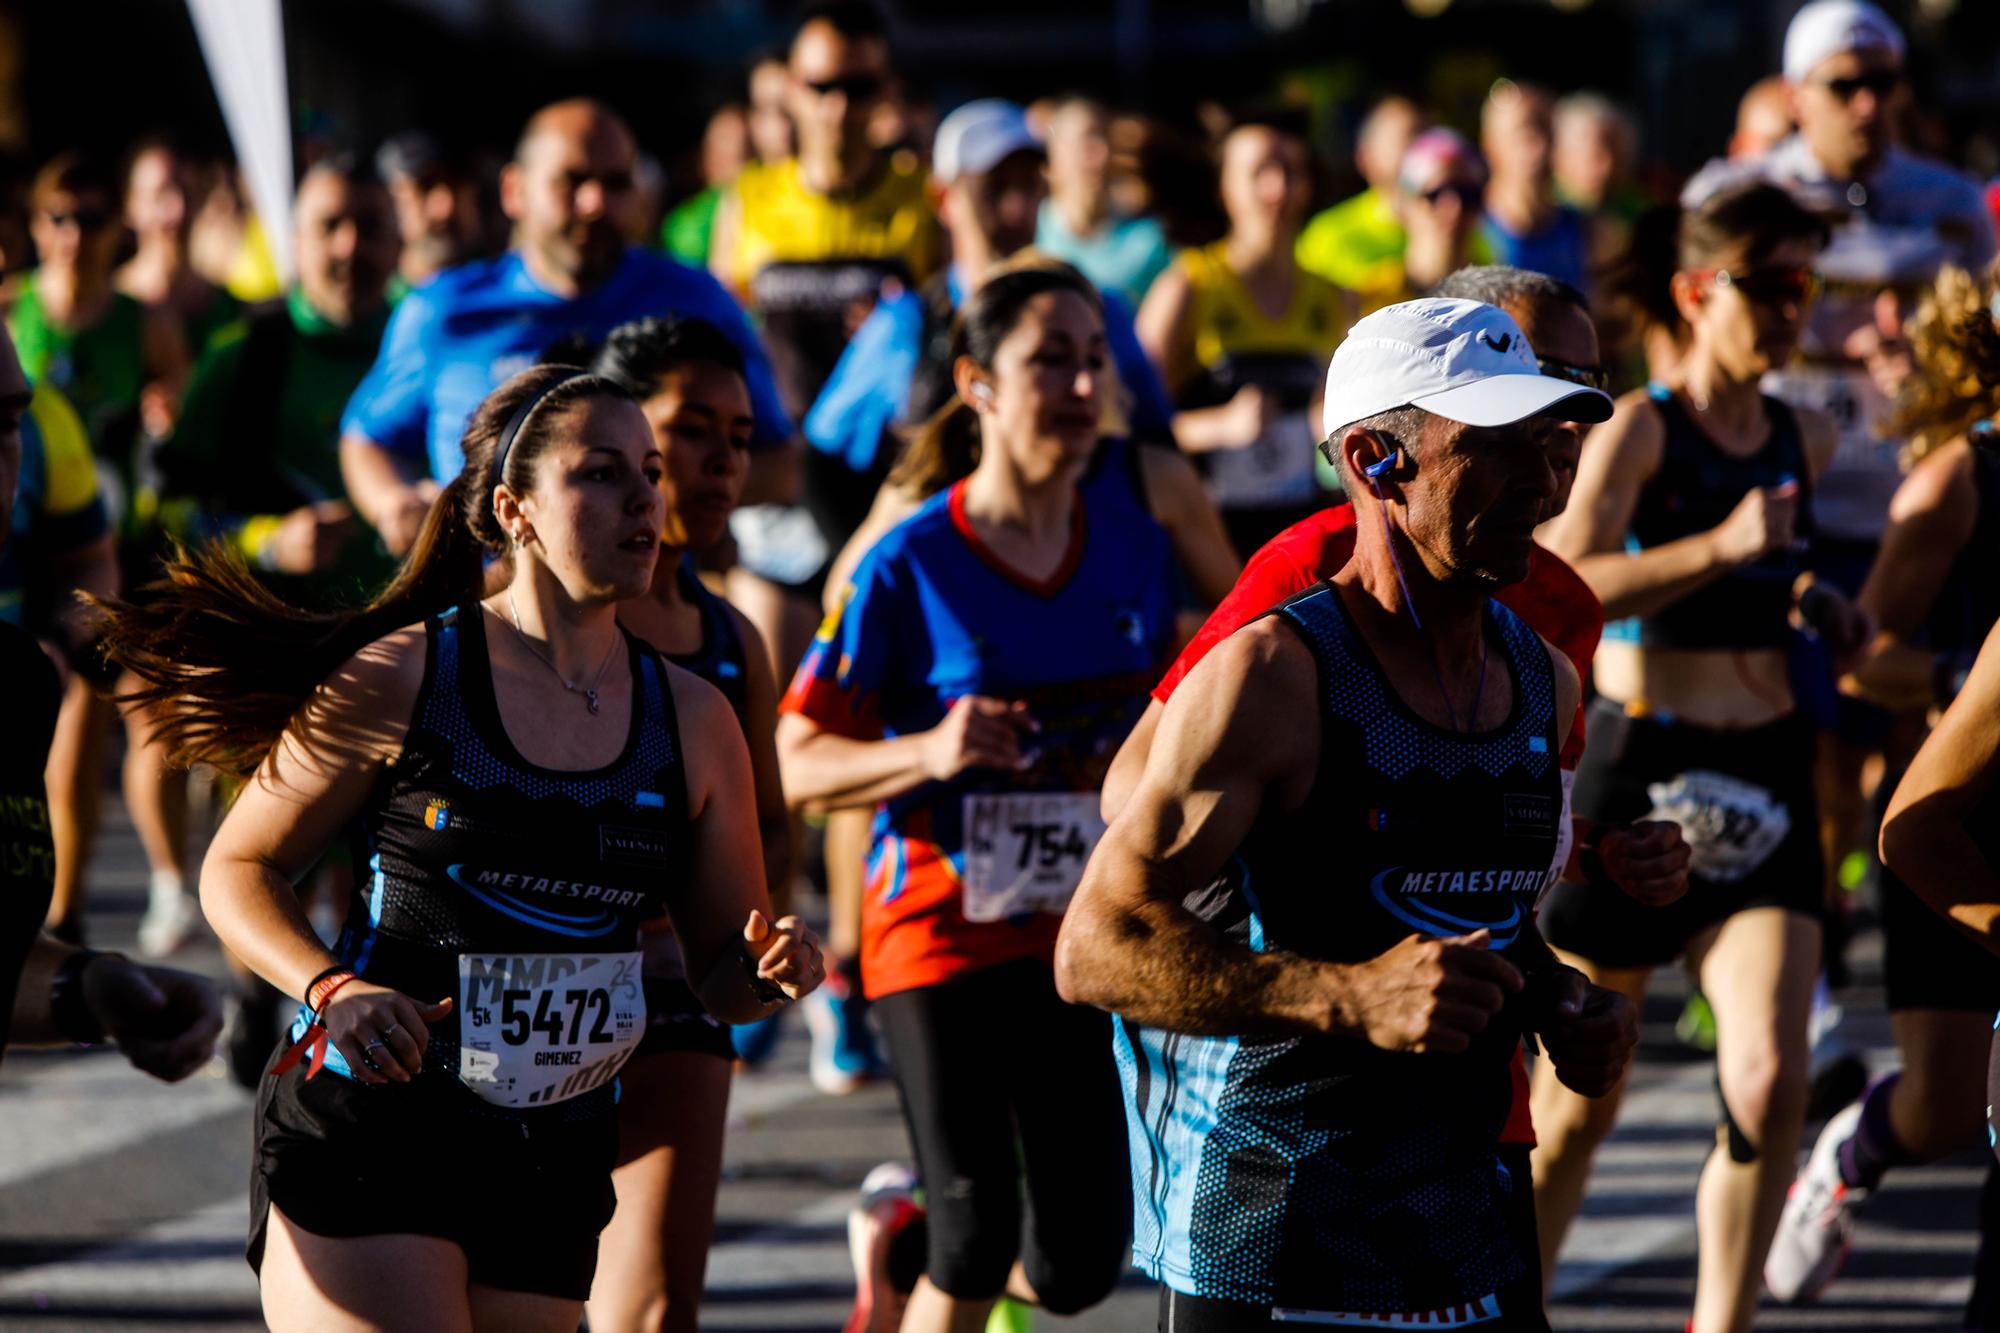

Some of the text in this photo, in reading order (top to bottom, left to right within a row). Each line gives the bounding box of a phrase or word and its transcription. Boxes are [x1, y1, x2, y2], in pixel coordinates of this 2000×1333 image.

[1010, 823, 1087, 870] 754
[477, 870, 646, 908] METAESPORT
[1400, 869, 1544, 893] METAESPORT
[501, 987, 614, 1046] 5472
[534, 1050, 583, 1067] GIMENEZ
